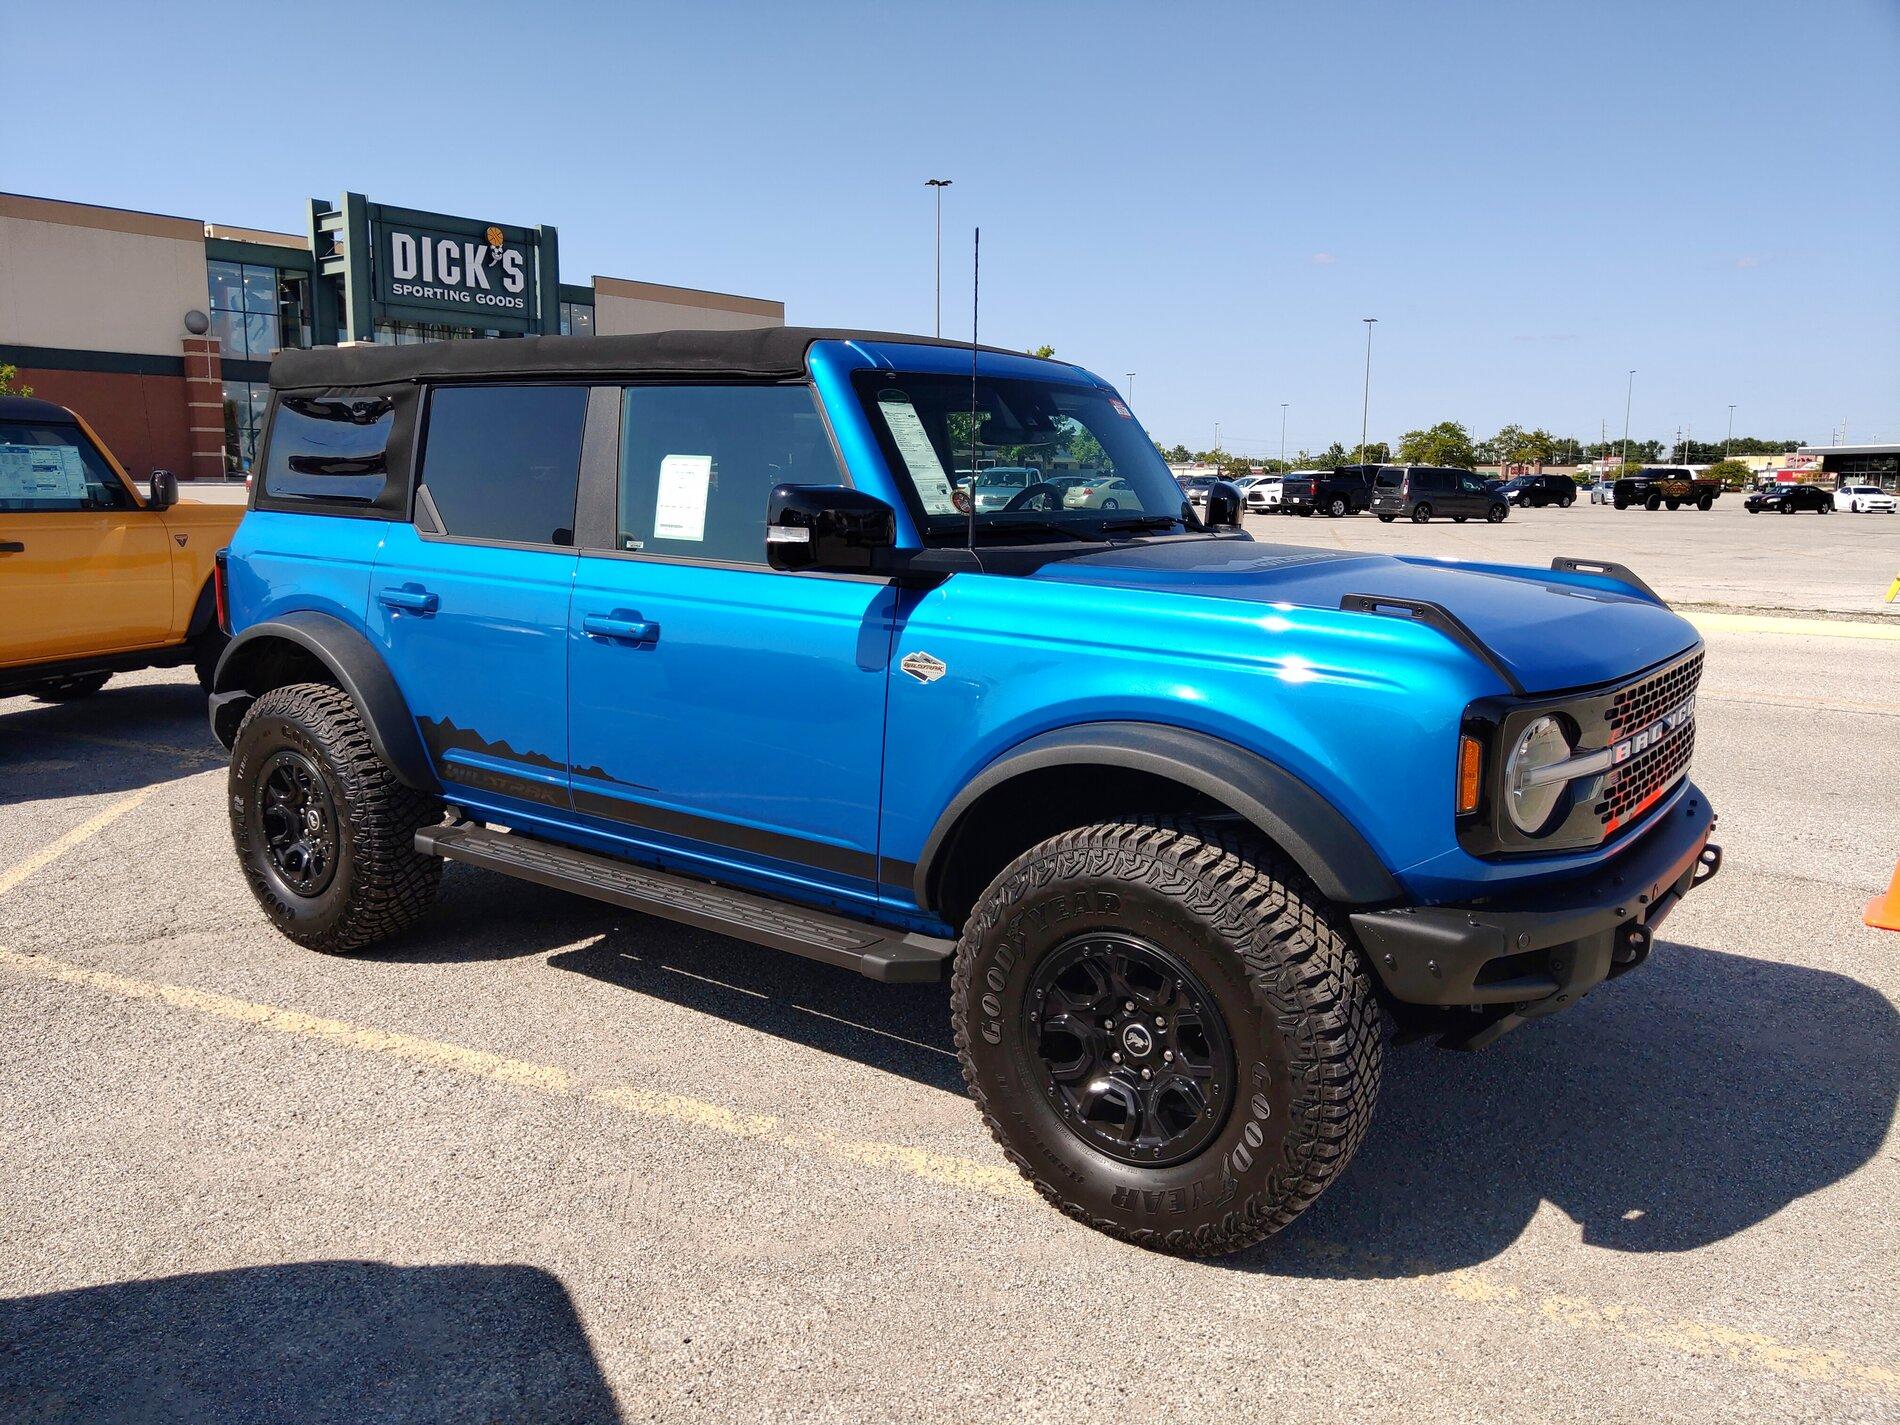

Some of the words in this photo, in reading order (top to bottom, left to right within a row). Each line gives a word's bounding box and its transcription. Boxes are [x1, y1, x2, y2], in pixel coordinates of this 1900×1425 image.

[391, 232, 525, 293] DICK'S
[392, 284, 471, 302] SPORTING
[475, 293, 524, 308] GOODS
[1611, 694, 1695, 764] BRONCO
[981, 891, 1121, 1045] GOODYEAR
[1110, 1061, 1272, 1216] GOODYEAR
